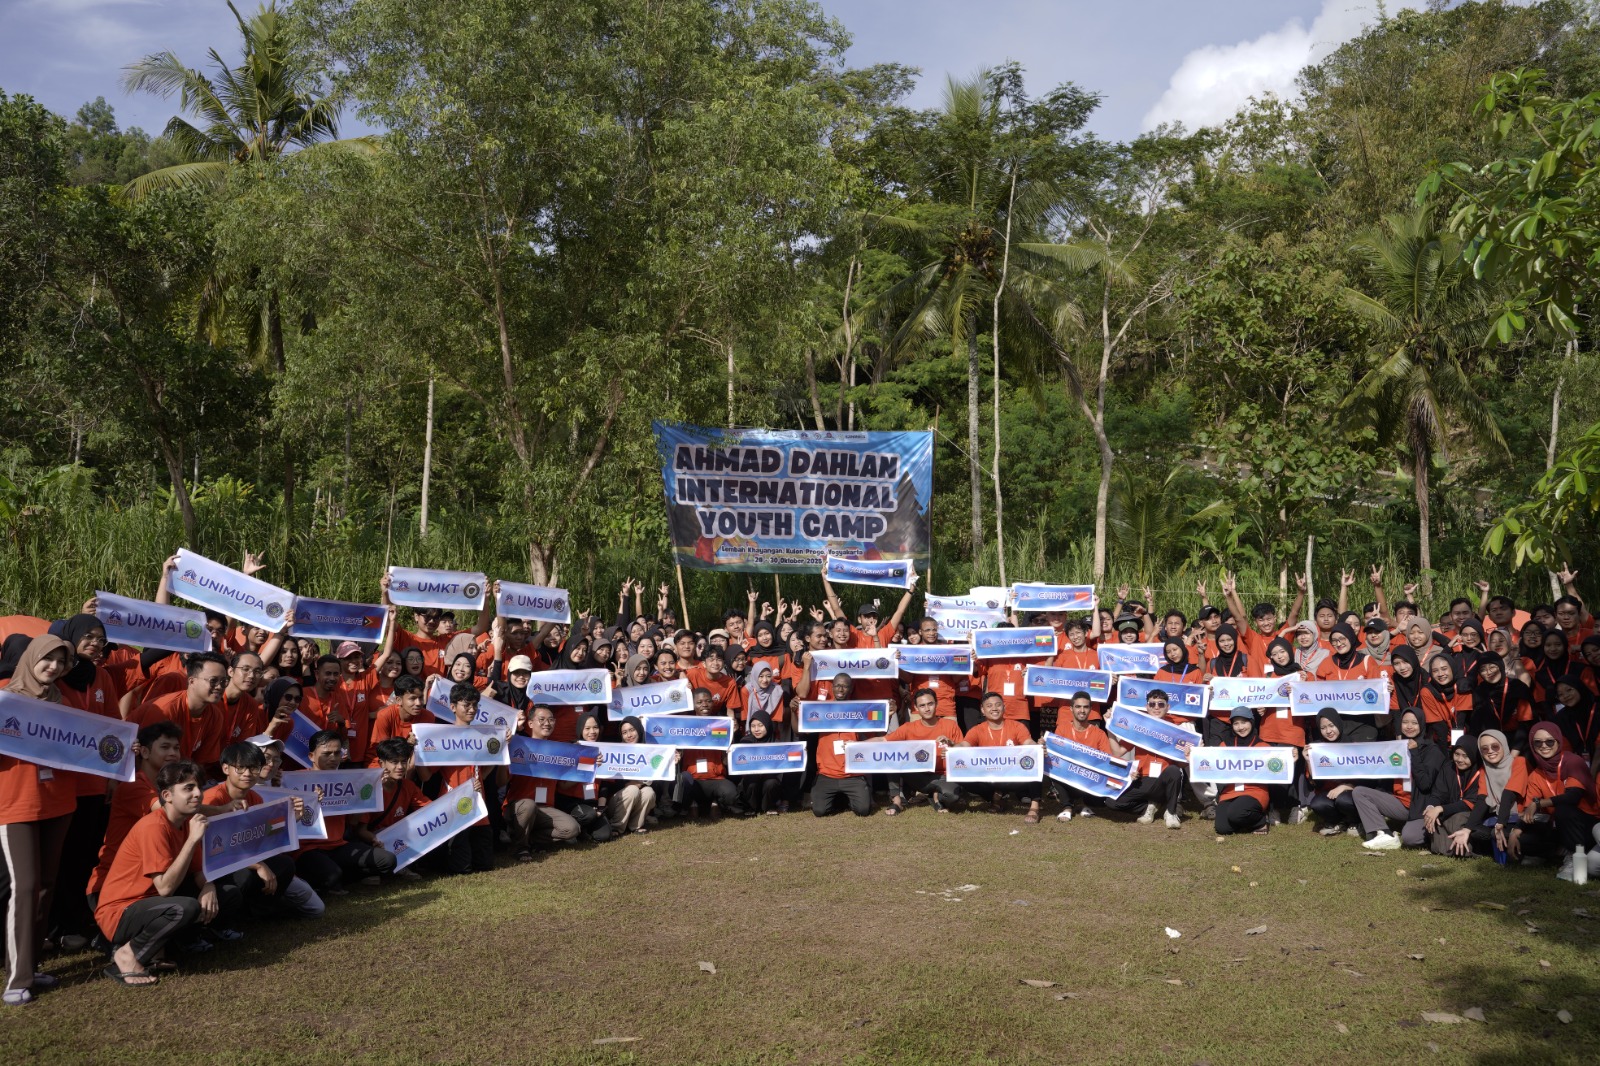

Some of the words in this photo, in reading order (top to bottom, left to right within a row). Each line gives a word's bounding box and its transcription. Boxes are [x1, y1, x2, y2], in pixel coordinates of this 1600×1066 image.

[676, 446, 781, 474] AHMAD
[791, 450, 898, 479] DAHLAN
[677, 478, 895, 508] INTERNATIONAL
[699, 510, 792, 536] YOUTH
[803, 511, 884, 539] CAMP
[198, 576, 264, 610] UNIMUDA
[417, 582, 459, 594] UMKT
[517, 595, 553, 609] UMSU
[127, 613, 185, 633] UMMAT
[946, 619, 988, 629] UNISA
[837, 660, 871, 669] UMP
[544, 683, 588, 692] UHAMKA
[1248, 685, 1266, 693] UM
[630, 694, 662, 708] UAD
[1237, 693, 1273, 703] METRO
[1315, 692, 1362, 702] UNIMUS
[27, 721, 98, 750] UNIMMA
[668, 728, 707, 737] GHANA
[441, 739, 483, 750] UMKU
[528, 752, 576, 767] INDONESIA
[872, 751, 910, 762] UMM
[970, 757, 1016, 766] UNMUH
[1336, 755, 1385, 766] UNISMA
[1215, 759, 1265, 771] UMPP
[416, 811, 448, 837] UMJ
[229, 823, 266, 847] SUDAN
